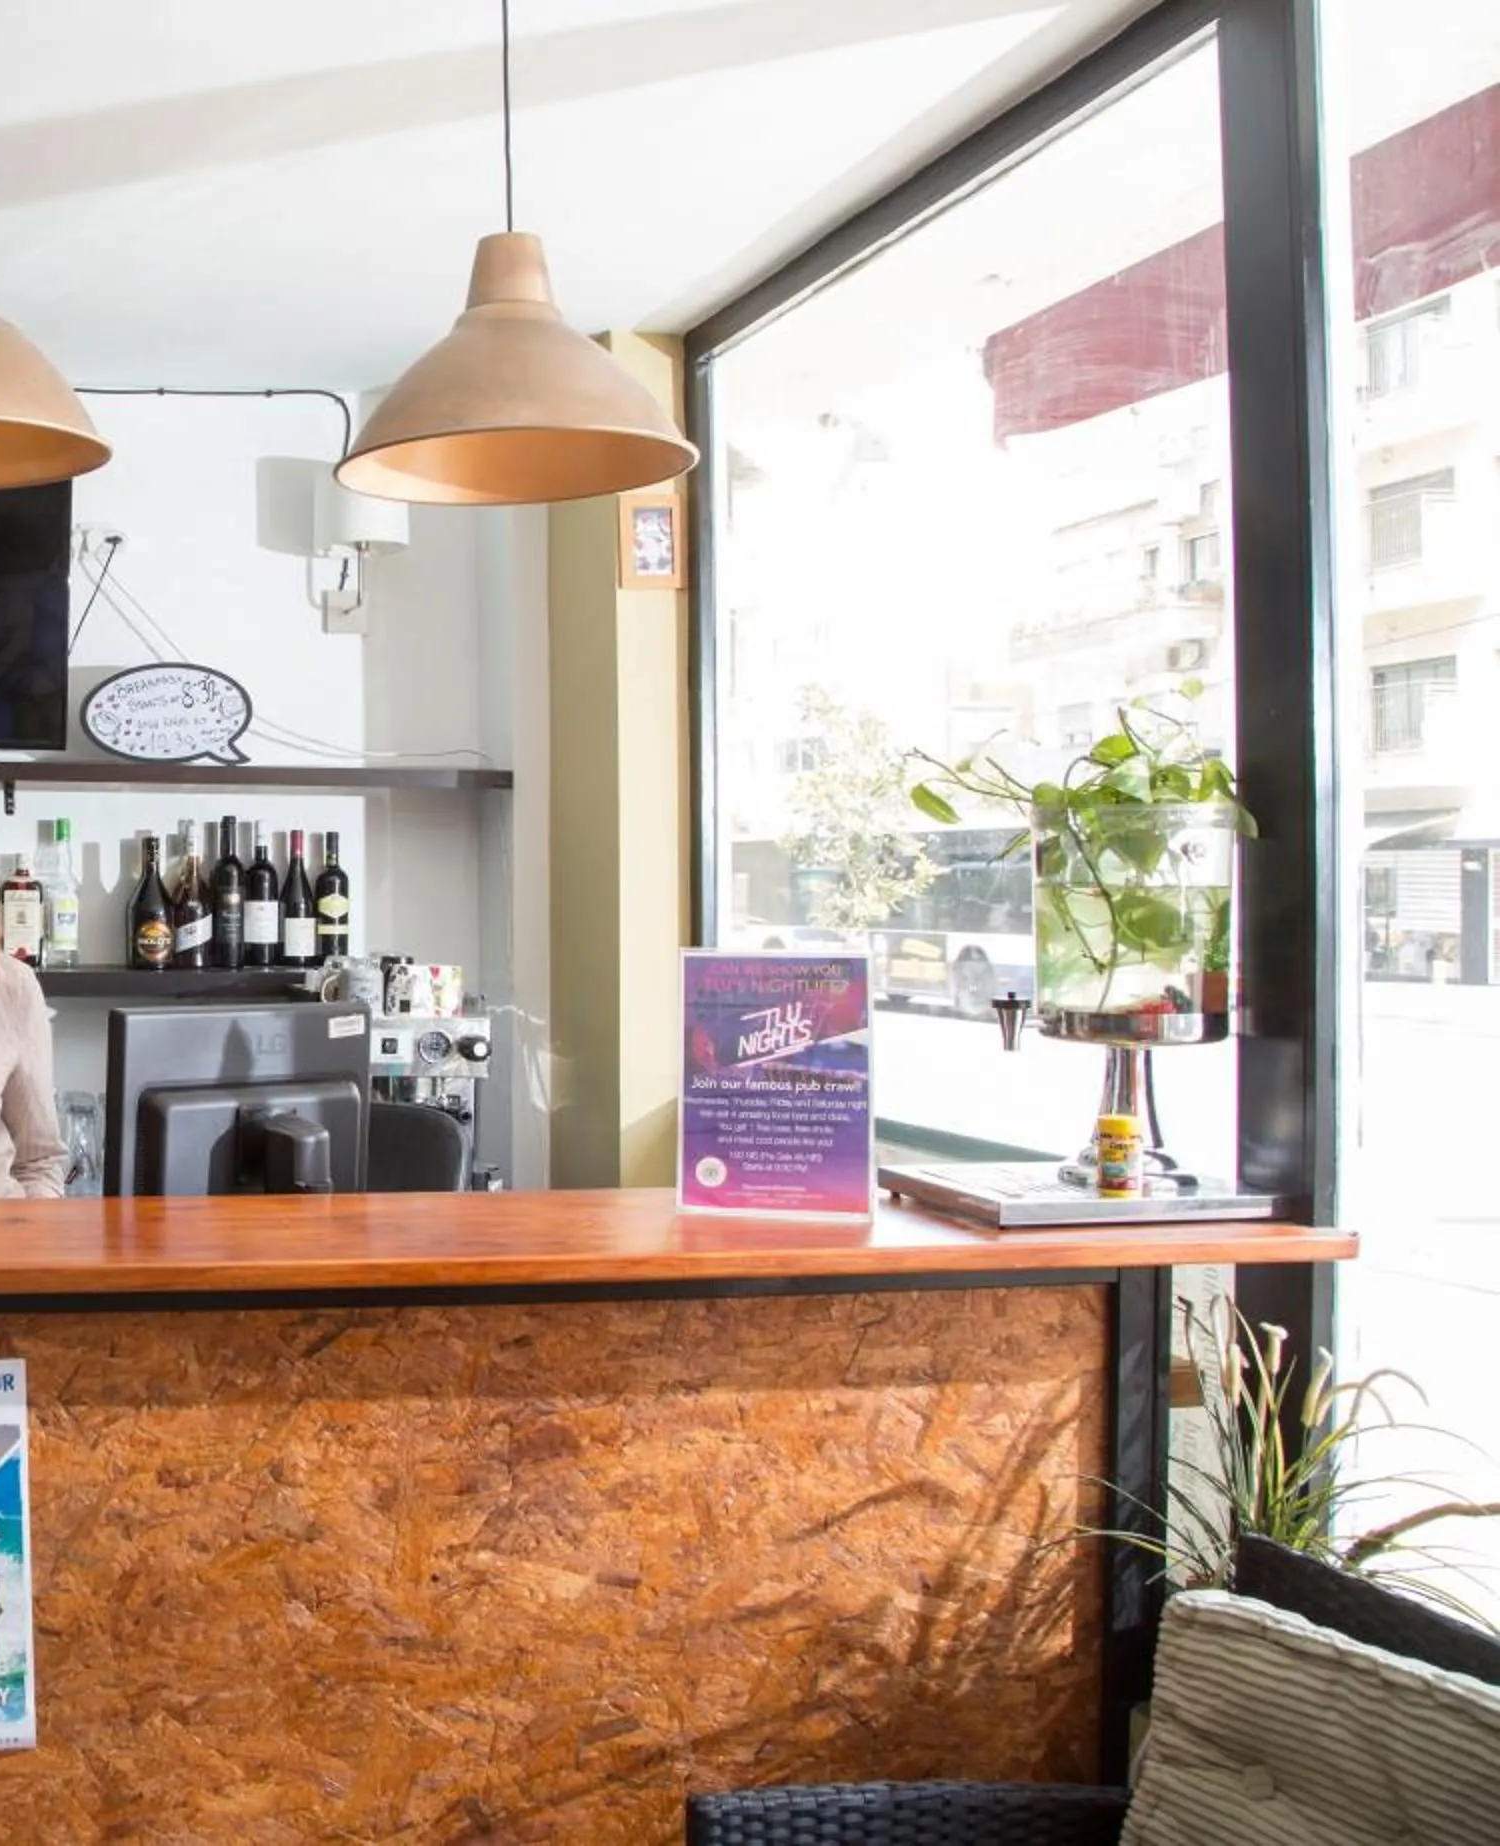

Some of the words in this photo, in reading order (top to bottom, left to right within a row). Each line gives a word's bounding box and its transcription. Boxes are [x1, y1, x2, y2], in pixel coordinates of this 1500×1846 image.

[813, 964, 842, 977] YOU
[691, 1075, 717, 1089] Join
[721, 1080, 742, 1089] our
[745, 1076, 792, 1091] famous
[795, 1080, 821, 1094] pub
